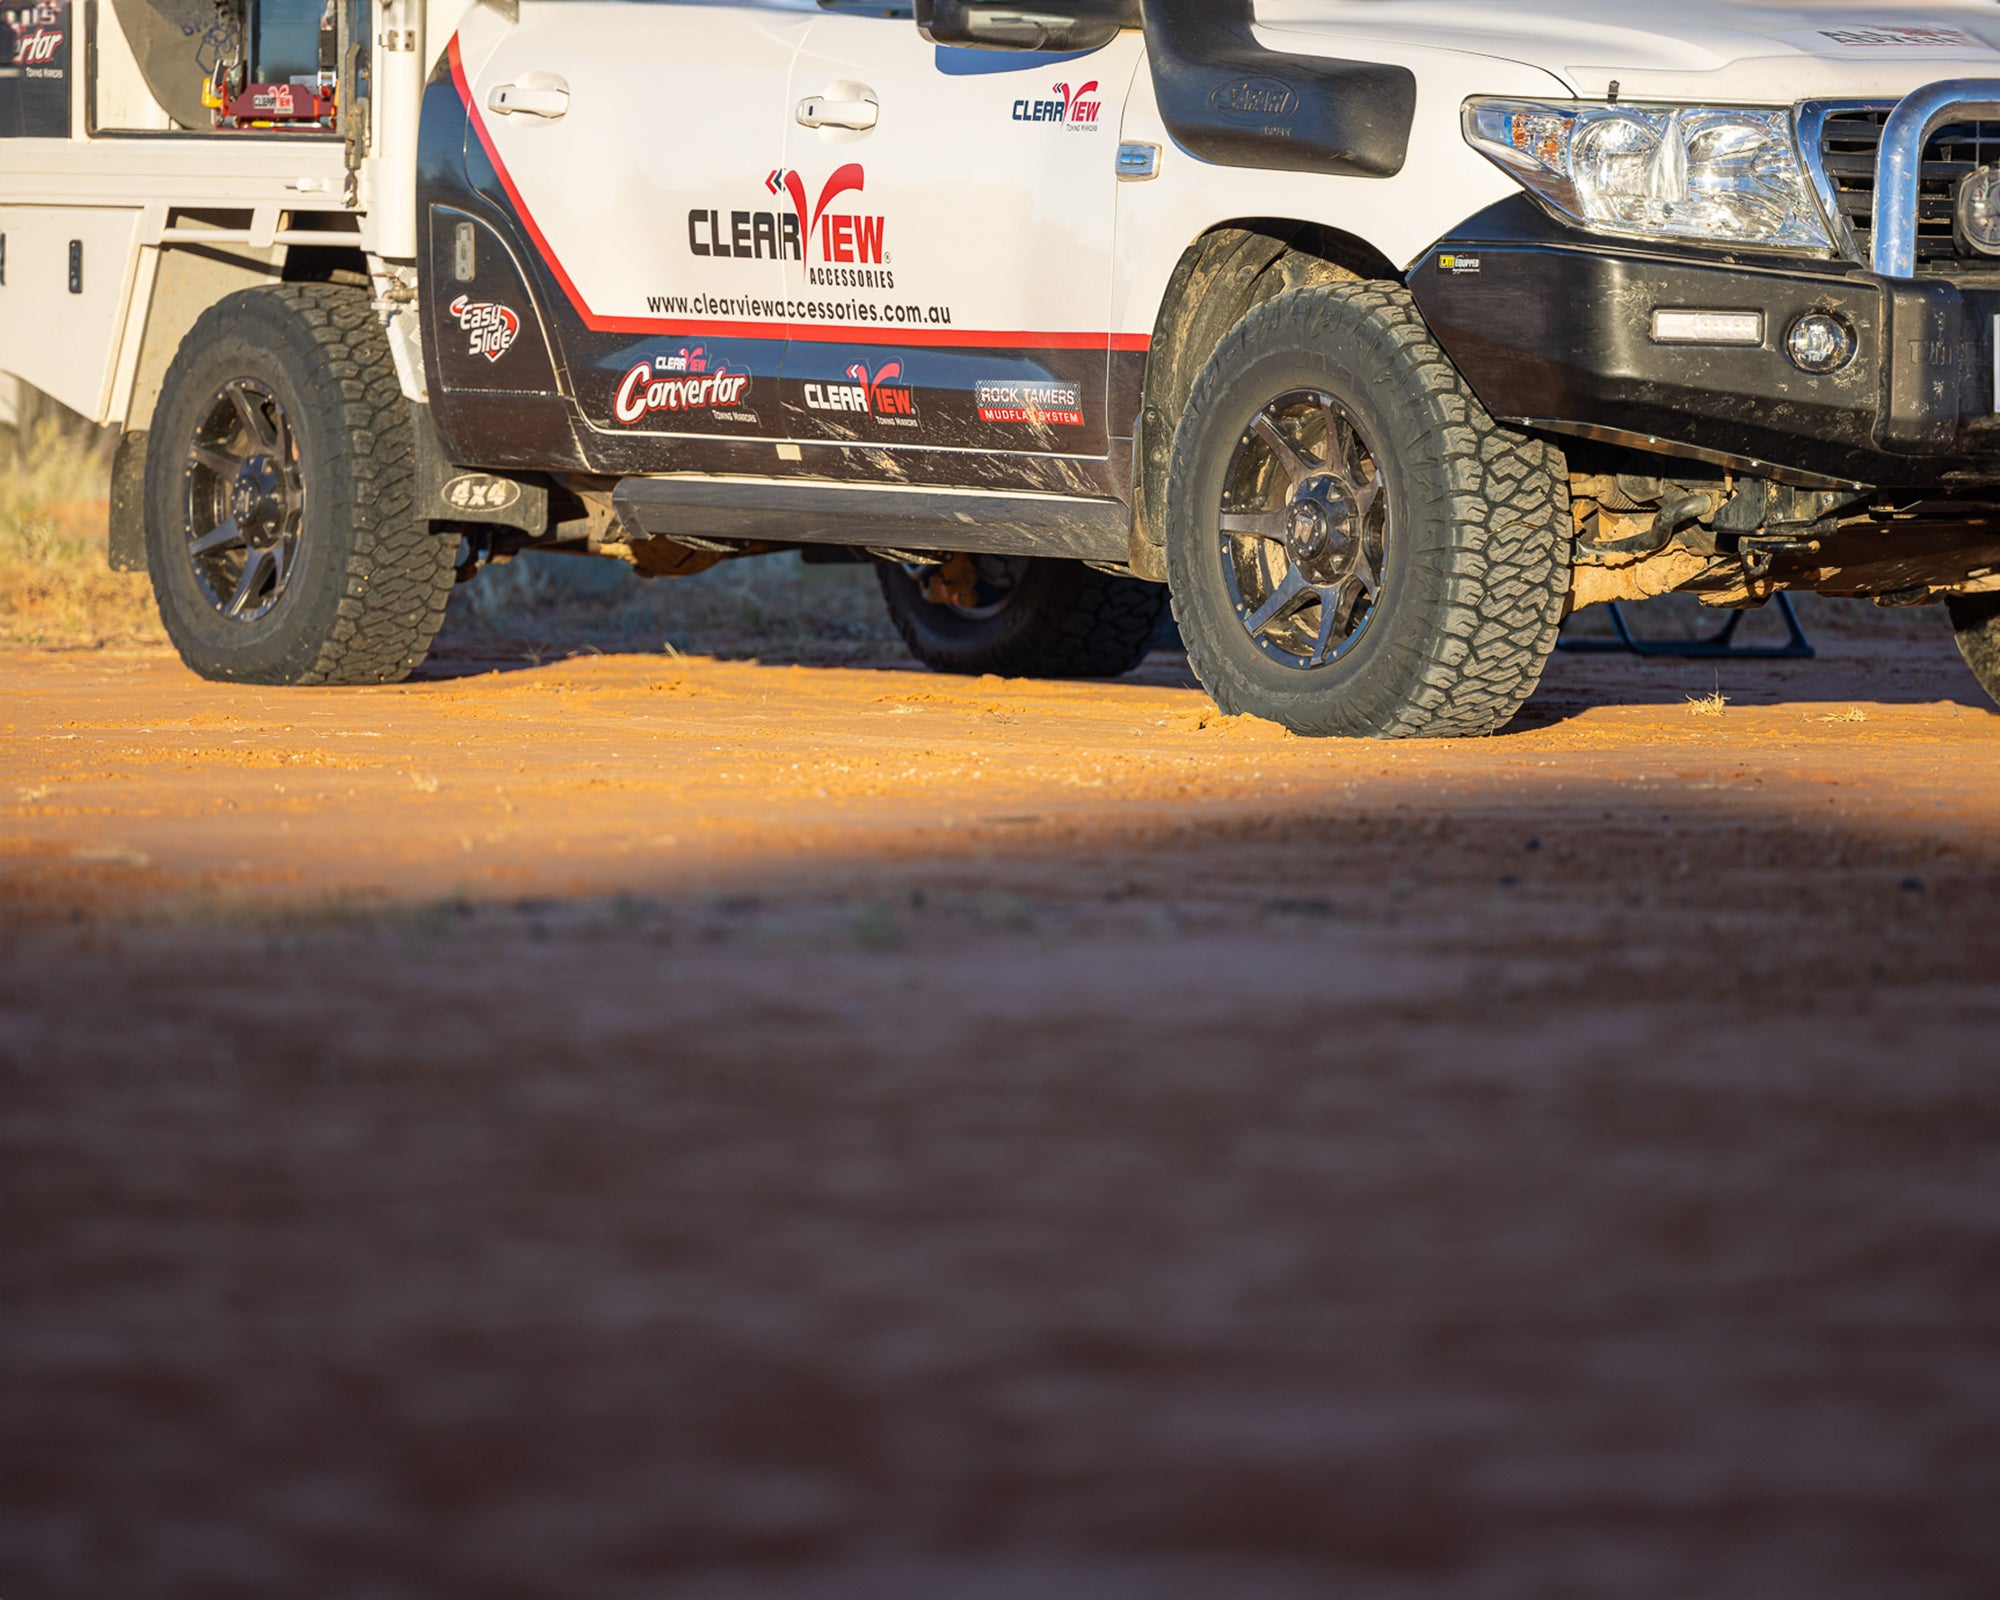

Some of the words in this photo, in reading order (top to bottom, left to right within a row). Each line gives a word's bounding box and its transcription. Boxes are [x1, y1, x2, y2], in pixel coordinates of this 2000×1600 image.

[1012, 80, 1101, 129] CLEARVIEW
[809, 267, 895, 289] ACCESSORIES
[460, 304, 502, 331] Easy
[647, 293, 952, 325] www.clearviewaccessories.com.au
[468, 325, 512, 356] Slide
[614, 362, 747, 424] Convertor
[804, 362, 912, 421] CLEARVIEW
[980, 386, 1020, 403] ROCK
[1022, 387, 1075, 405] TAMERS
[984, 409, 1035, 422] MUDFLA
[1037, 411, 1079, 423] SYSTEM
[450, 479, 506, 506] 4x4
